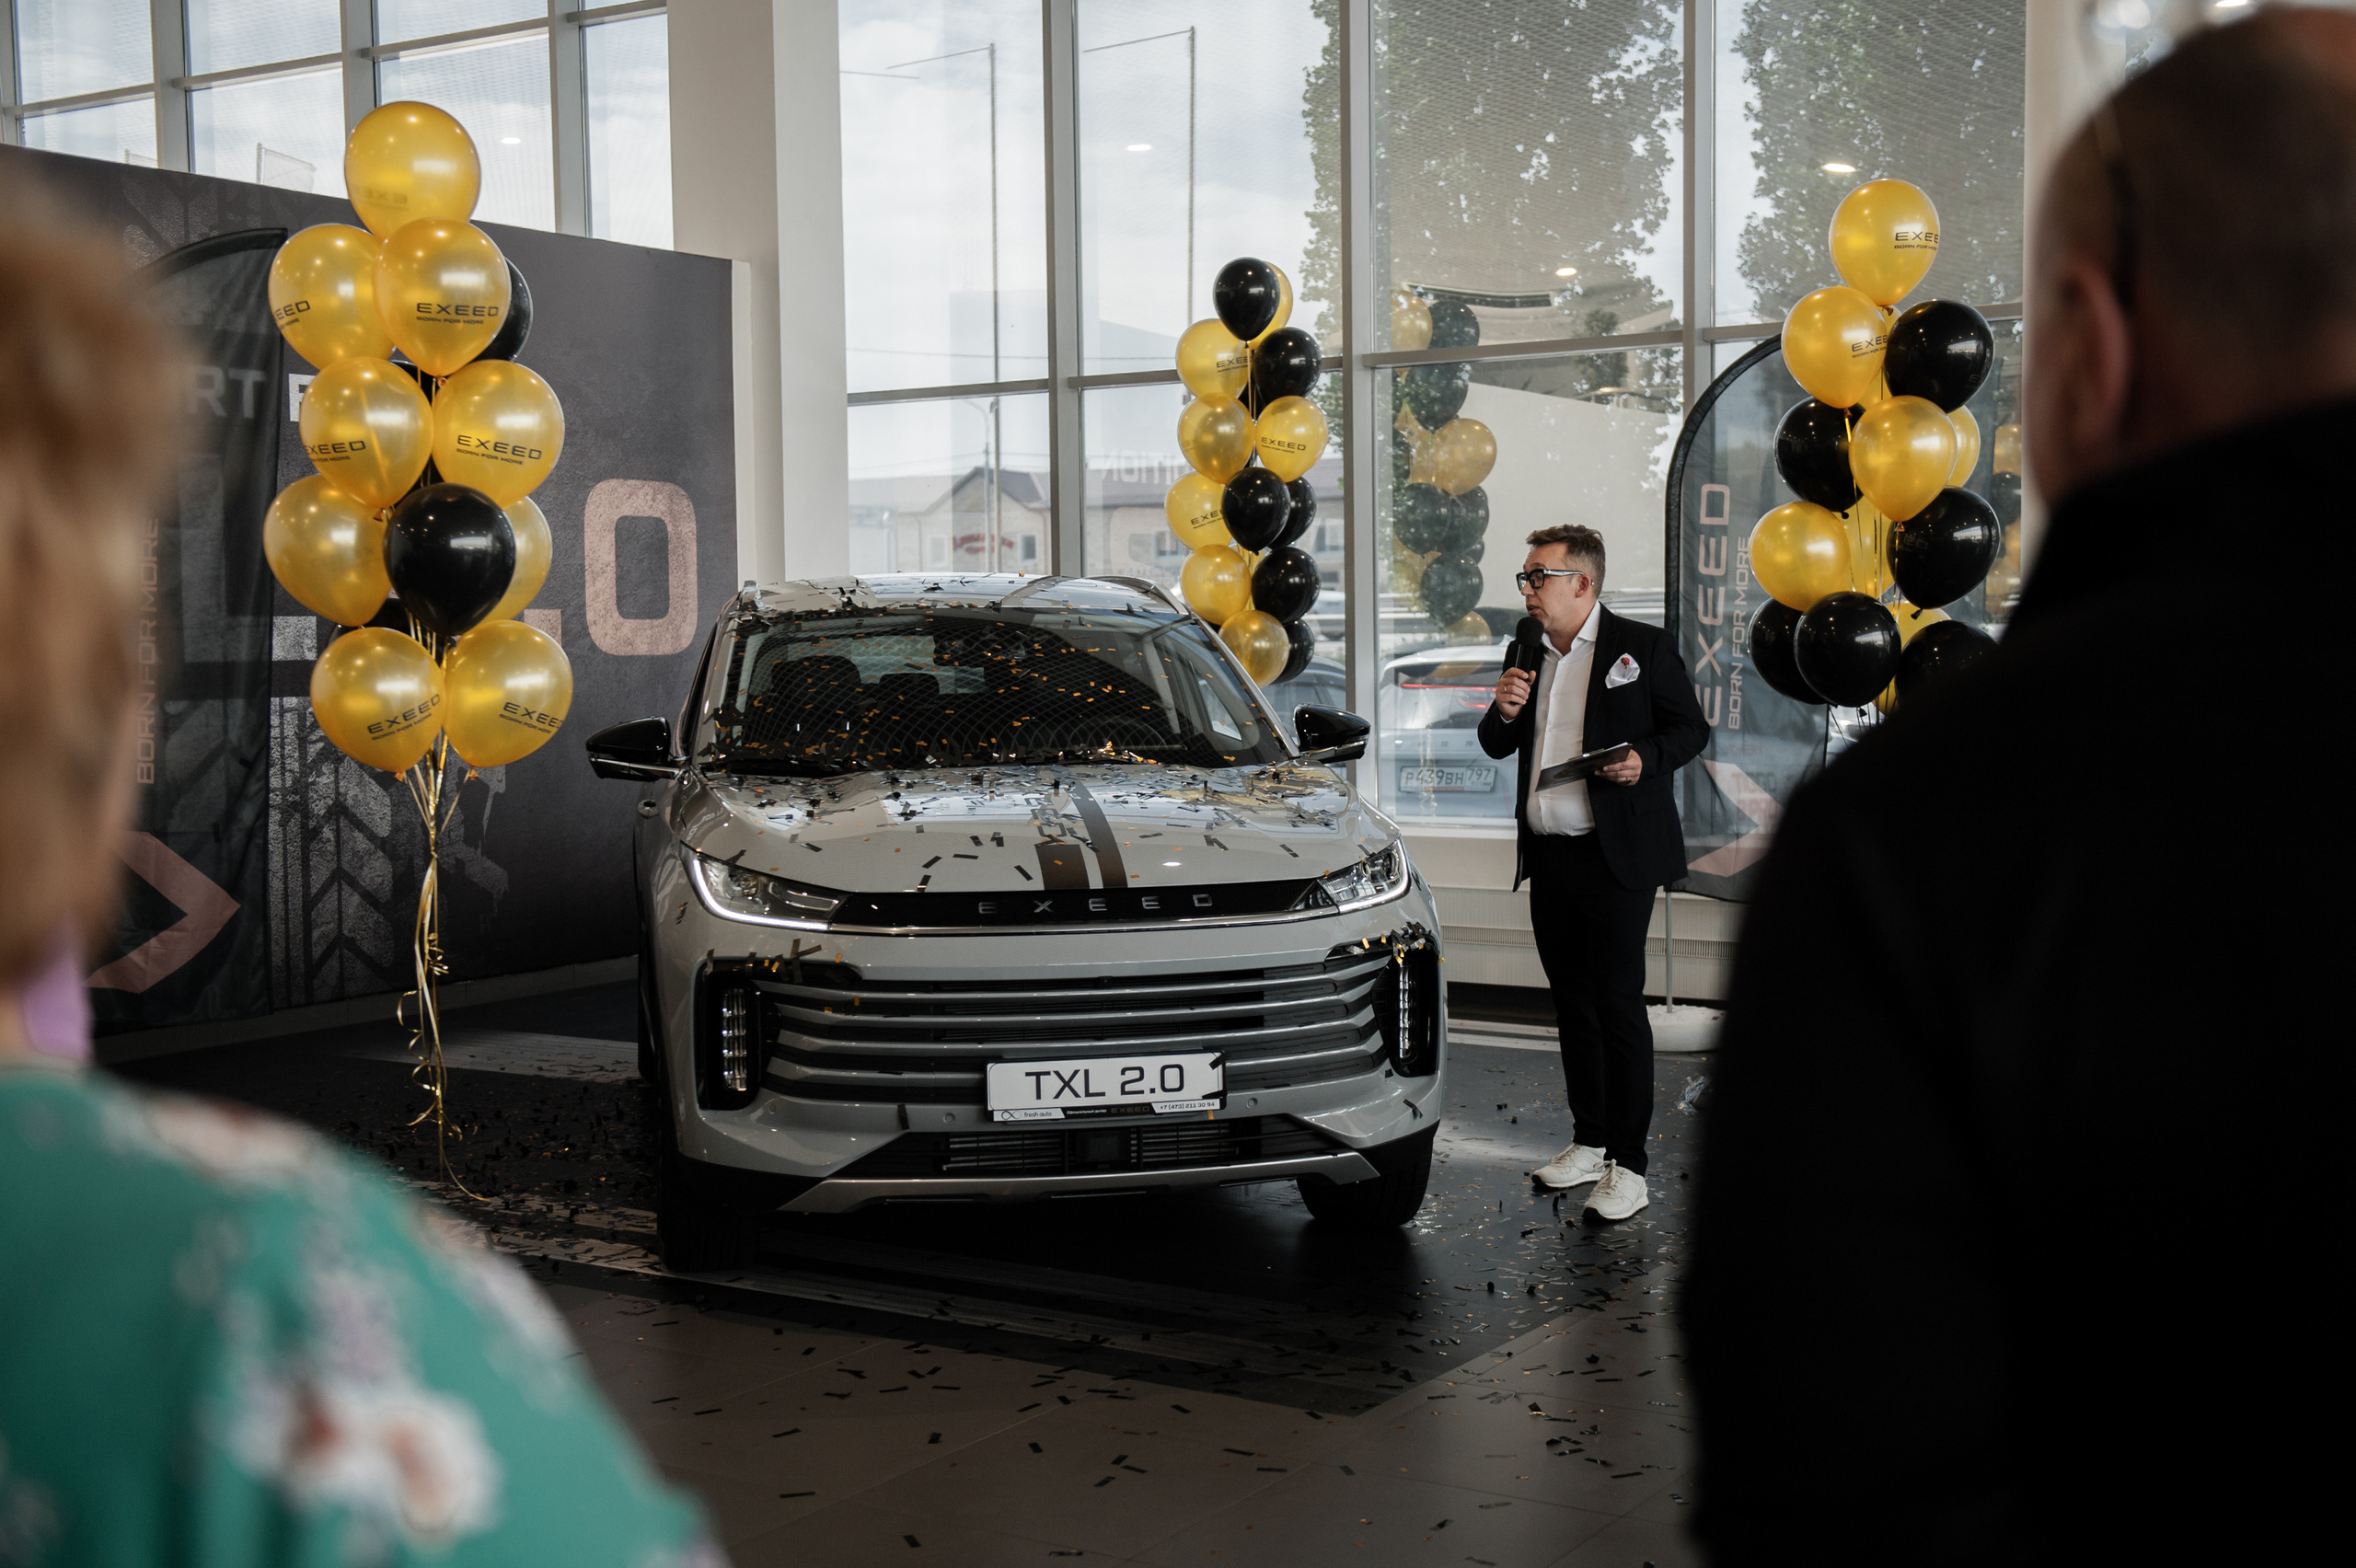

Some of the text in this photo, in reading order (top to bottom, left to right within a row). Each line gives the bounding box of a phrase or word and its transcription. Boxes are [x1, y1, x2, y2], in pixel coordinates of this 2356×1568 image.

[416, 302, 500, 317] EXEED
[456, 447, 479, 456] BORN
[480, 451, 499, 461] FOR
[457, 434, 542, 460] EXEED
[1261, 436, 1306, 451] EXEED
[1695, 483, 1731, 728] EXEED
[1727, 536, 1750, 730] BORN FOR MORE
[367, 693, 441, 734] EXEED
[1467, 768, 1491, 780] 797
[978, 894, 1213, 915] EXEED
[1024, 1064, 1184, 1101] TXL 2.0
[1111, 1105, 1149, 1113] EXEED
